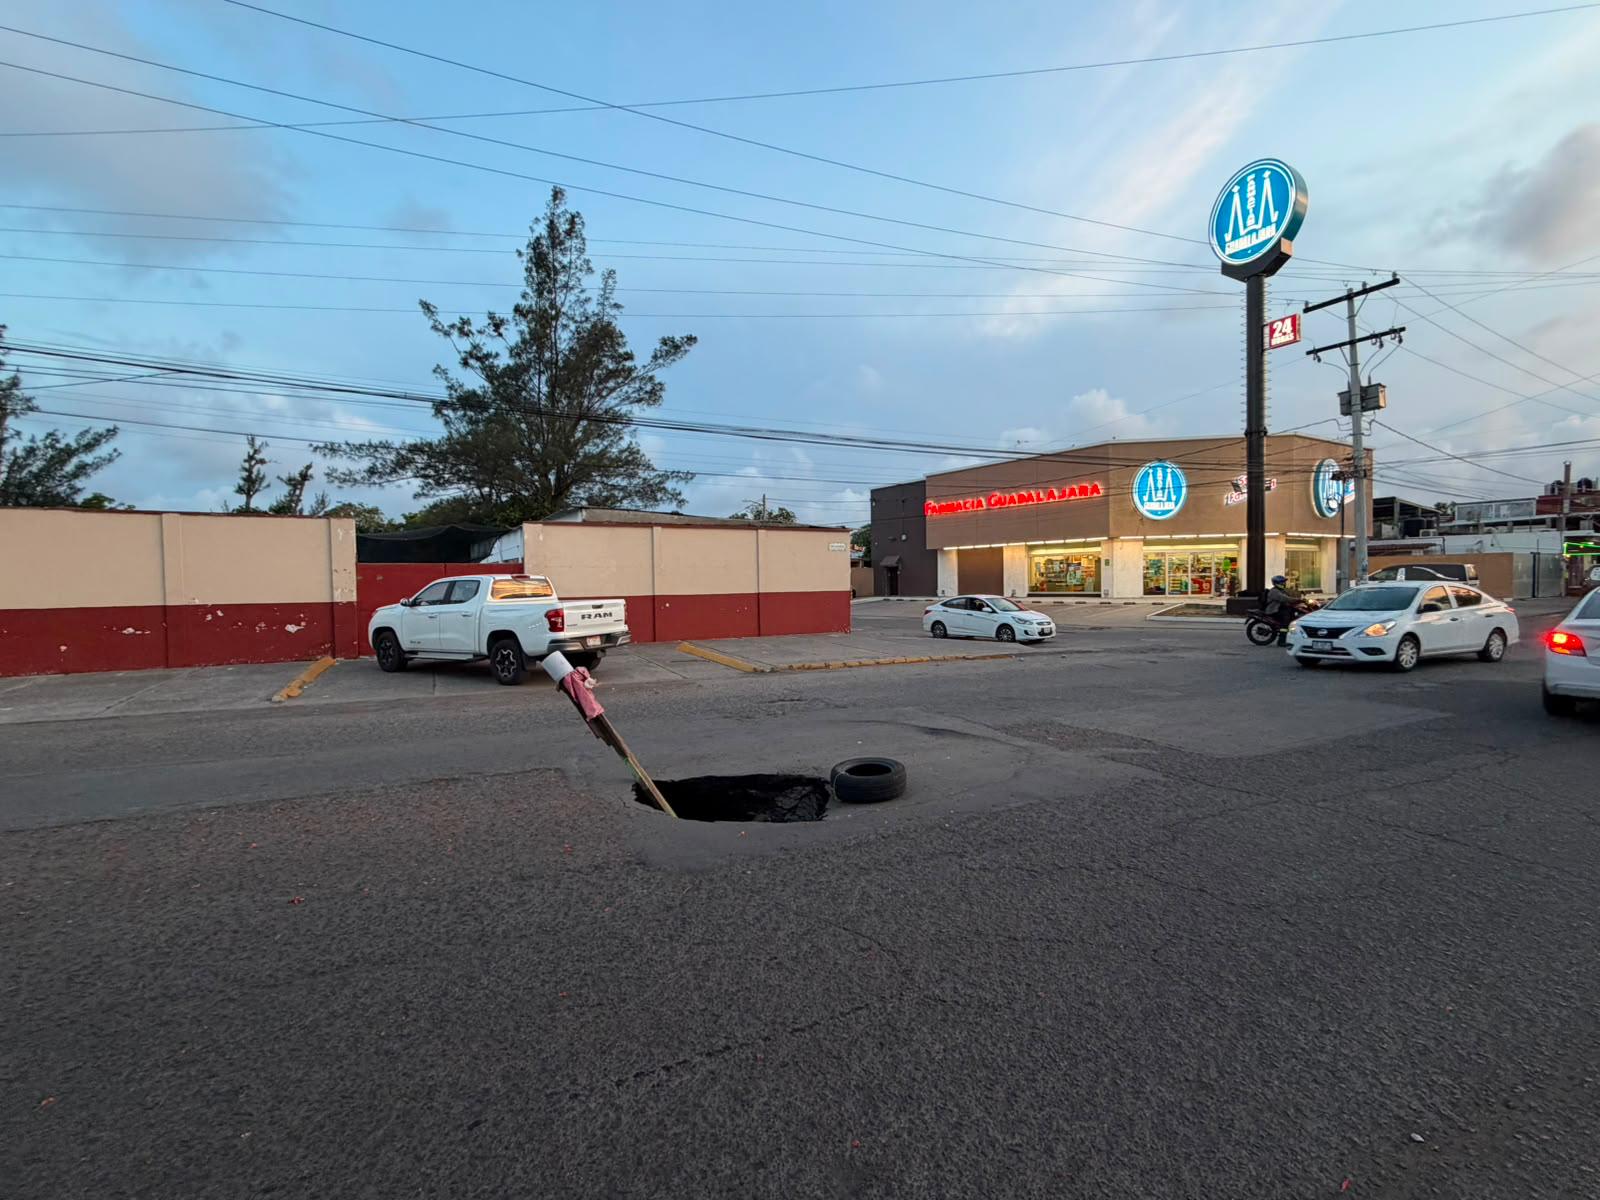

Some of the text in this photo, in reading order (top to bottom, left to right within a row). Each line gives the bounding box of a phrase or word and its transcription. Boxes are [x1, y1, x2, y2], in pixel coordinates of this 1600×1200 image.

[1272, 317, 1293, 338] 24
[924, 482, 1104, 516] FARMACIA GUADALAJARA
[581, 612, 613, 620] RAM
